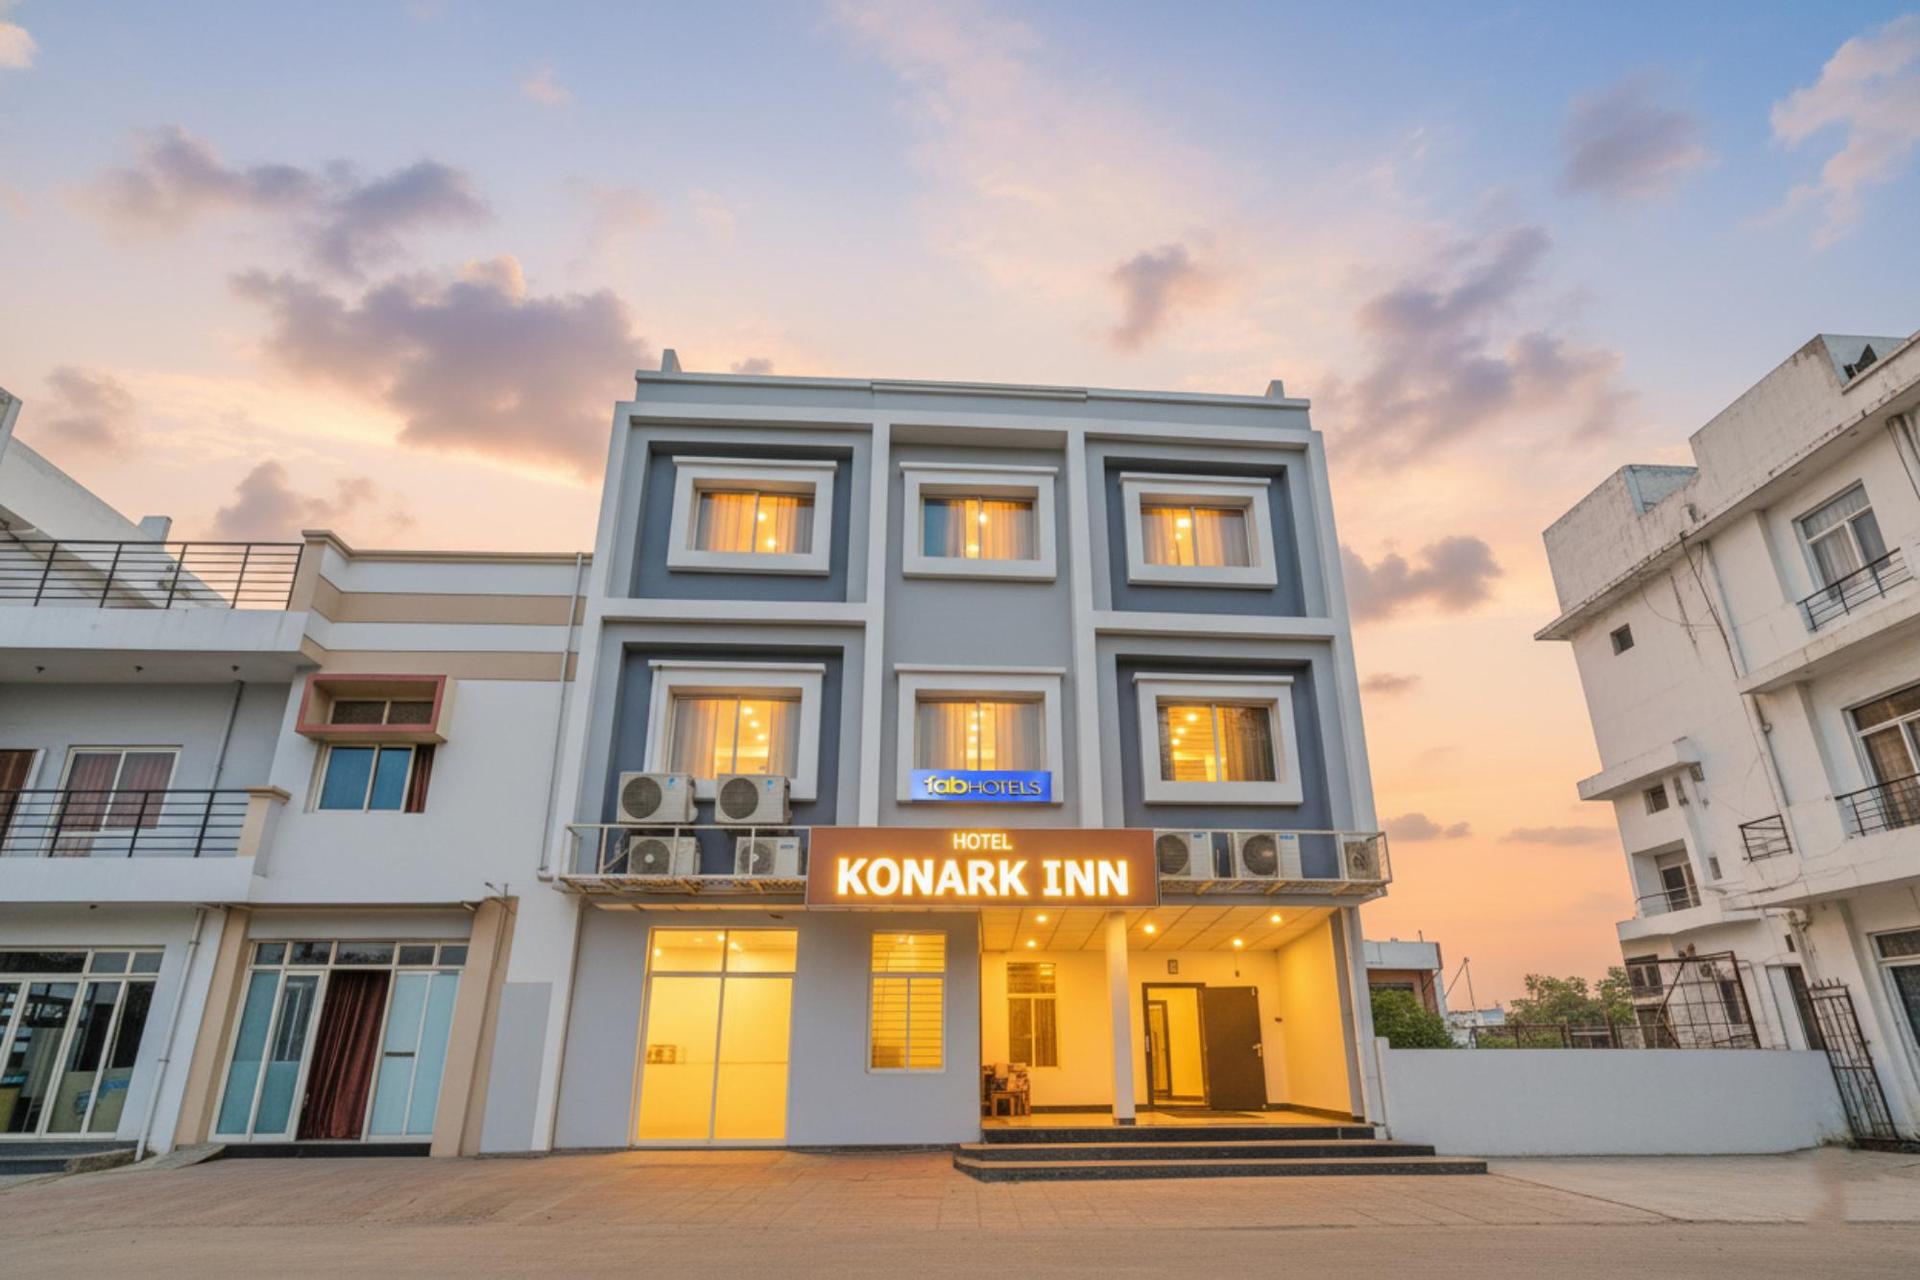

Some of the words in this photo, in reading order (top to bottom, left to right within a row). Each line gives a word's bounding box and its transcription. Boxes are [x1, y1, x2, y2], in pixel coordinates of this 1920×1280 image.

[953, 833, 1012, 850] HOTEL
[837, 858, 1028, 896] KONARK
[1042, 860, 1129, 897] INN
